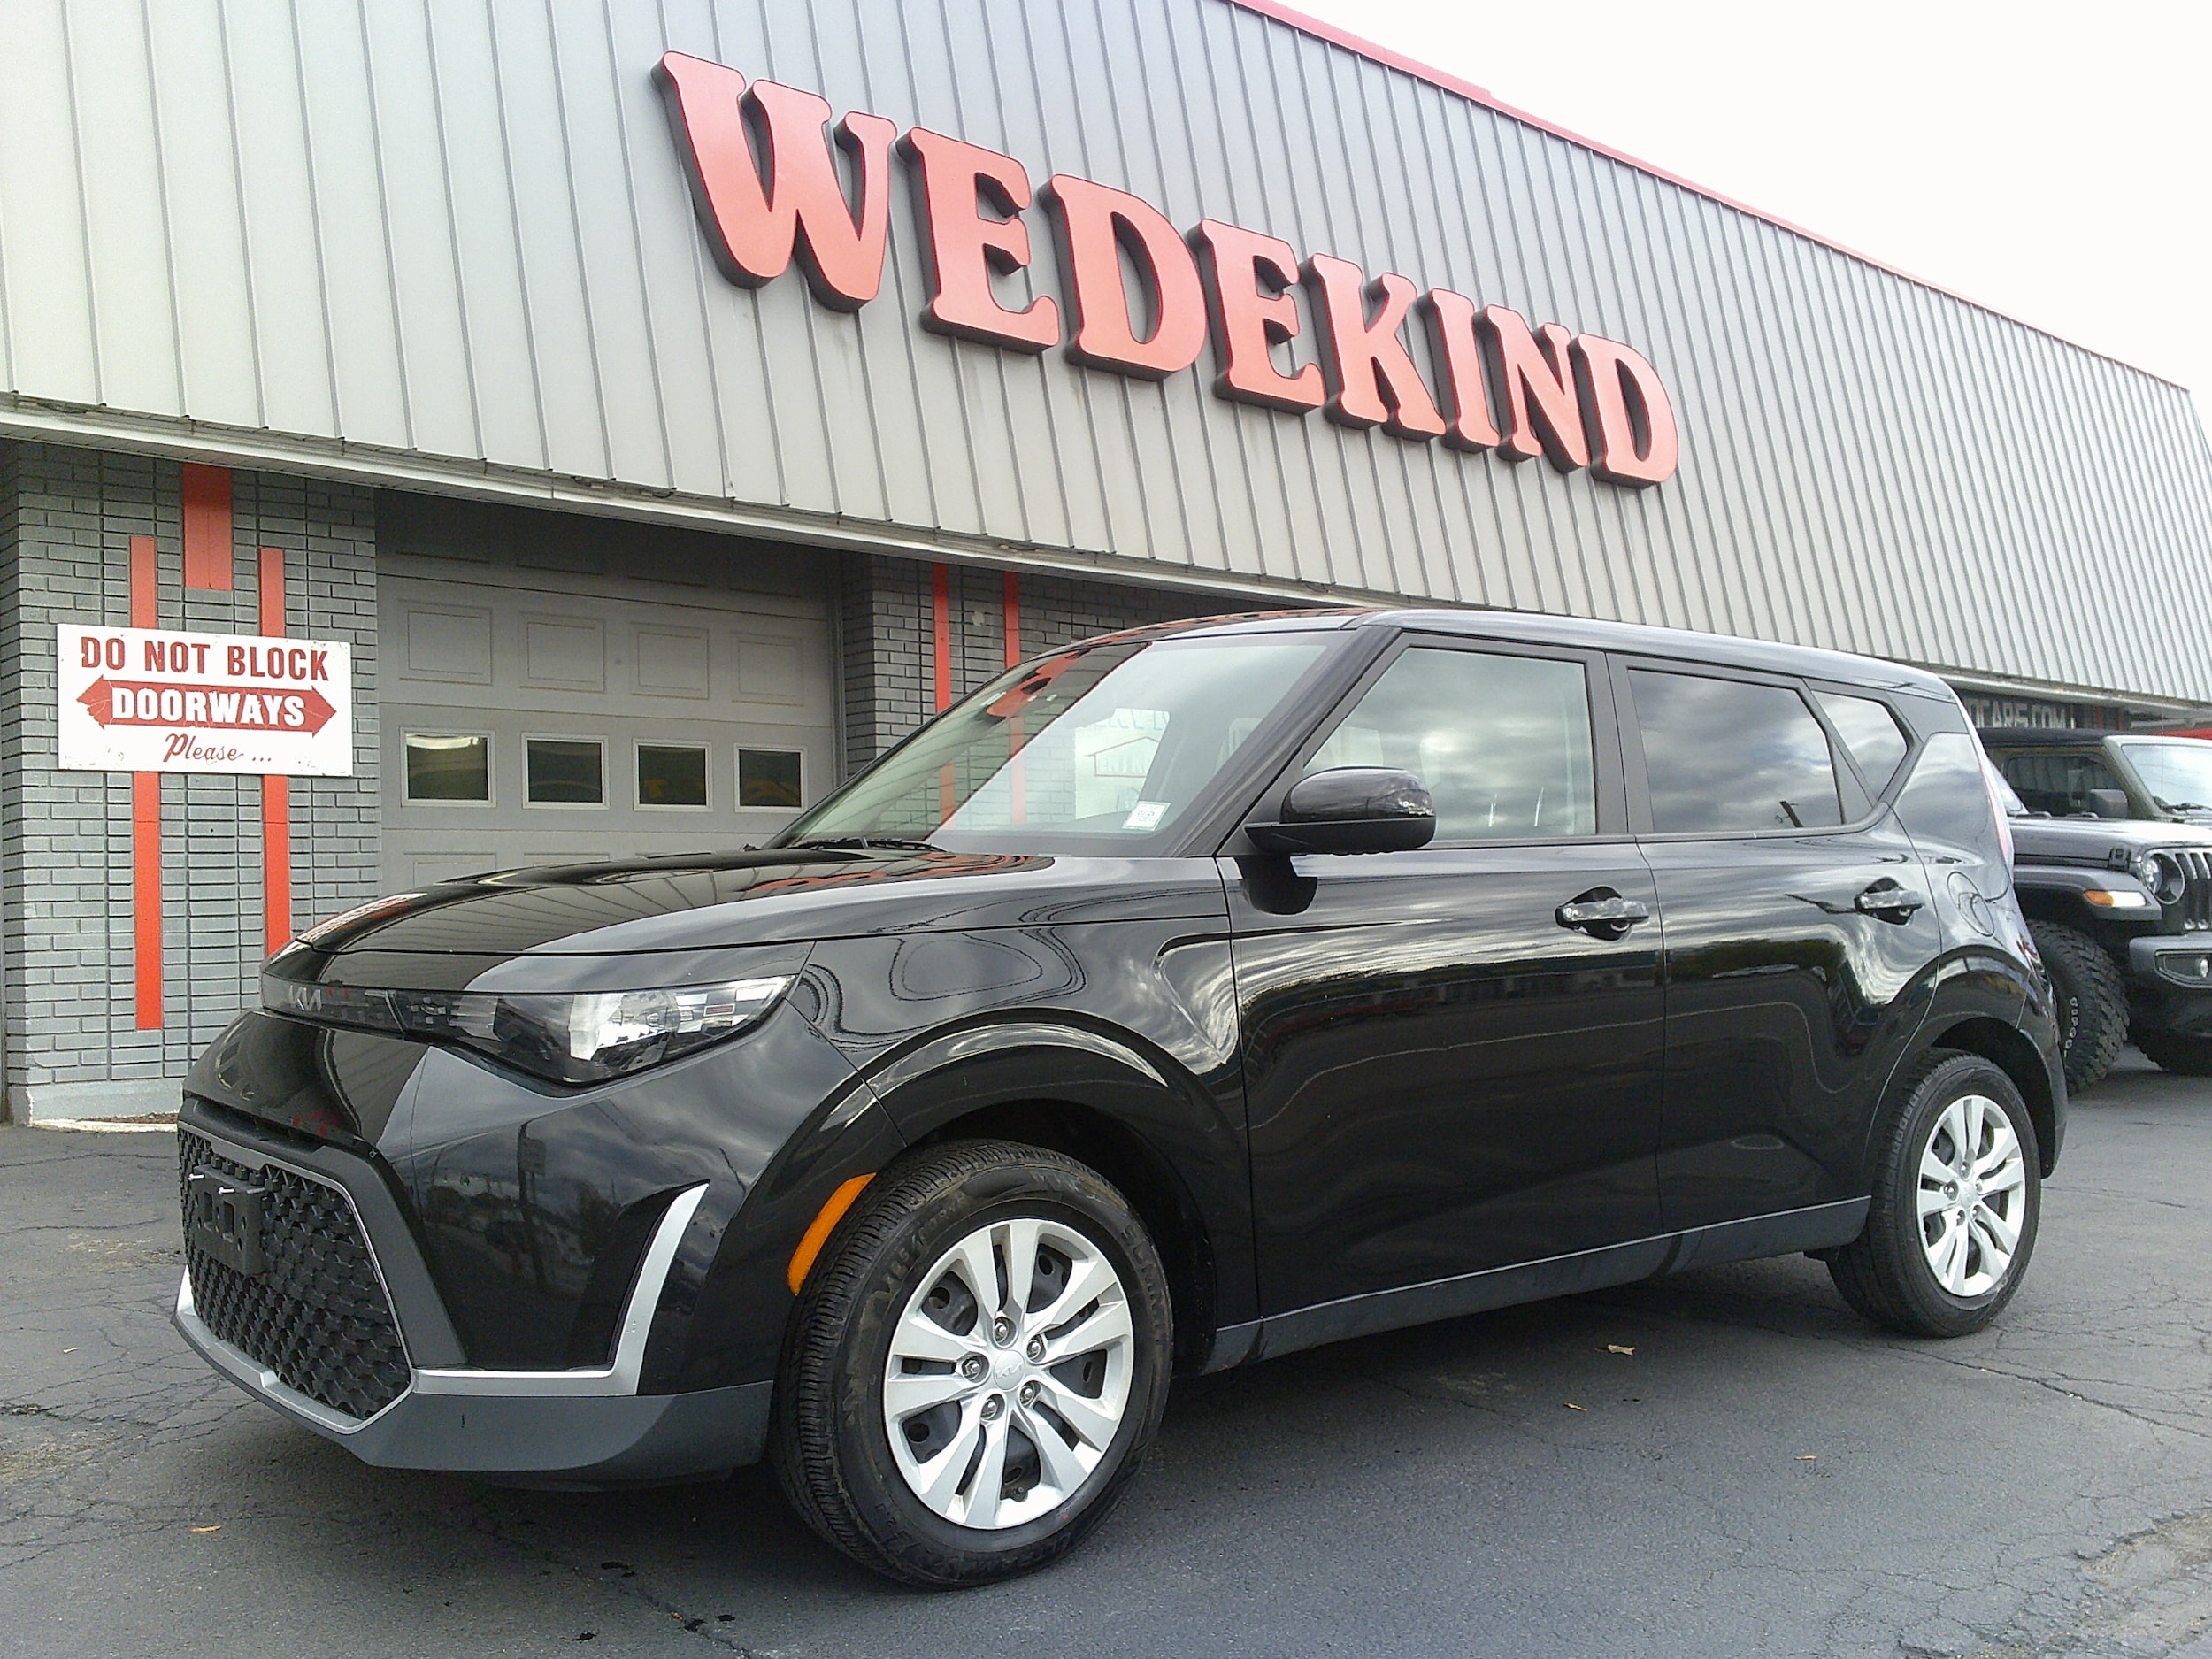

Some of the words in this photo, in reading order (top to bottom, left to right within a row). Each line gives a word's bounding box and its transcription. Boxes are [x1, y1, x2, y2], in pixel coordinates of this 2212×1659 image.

[653, 50, 1680, 488] WEDEKIND
[81, 636, 126, 670] DO
[145, 640, 211, 673] NOT
[227, 645, 329, 681] BLOCK
[111, 687, 305, 726] DOORWAYS
[163, 733, 243, 763] Please
